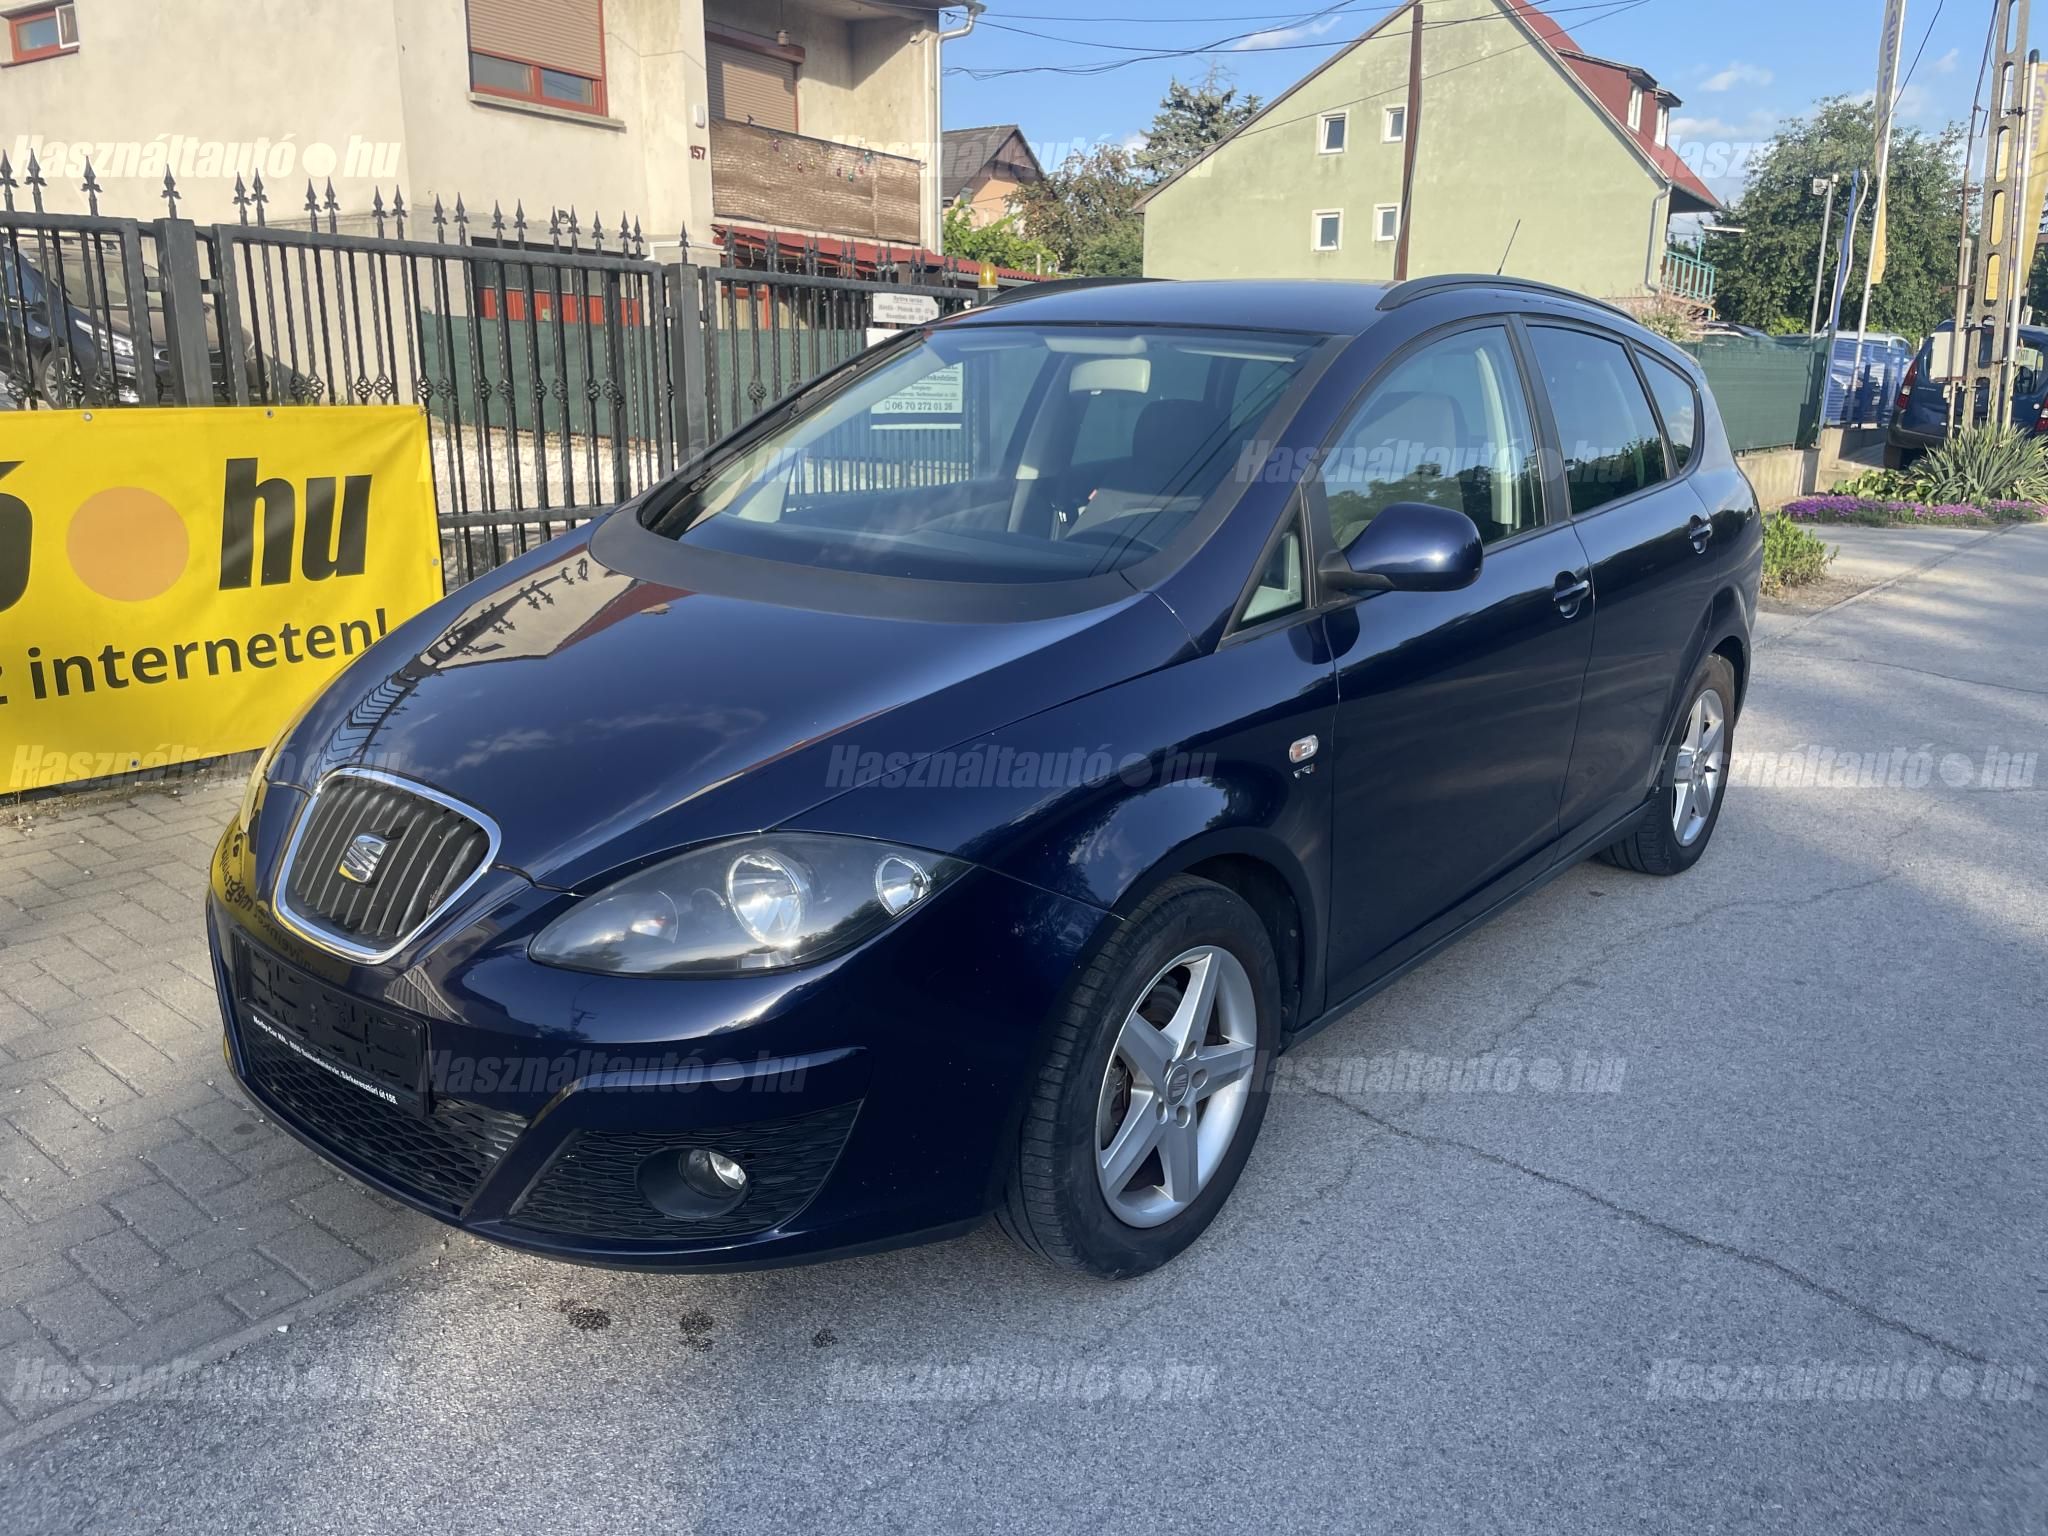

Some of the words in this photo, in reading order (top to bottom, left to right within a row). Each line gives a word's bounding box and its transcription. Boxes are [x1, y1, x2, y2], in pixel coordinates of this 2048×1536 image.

[690, 145, 706, 160] 157
[905, 401, 916, 410] 70
[917, 402, 932, 410] 272
[28, 608, 387, 700] interneten!
